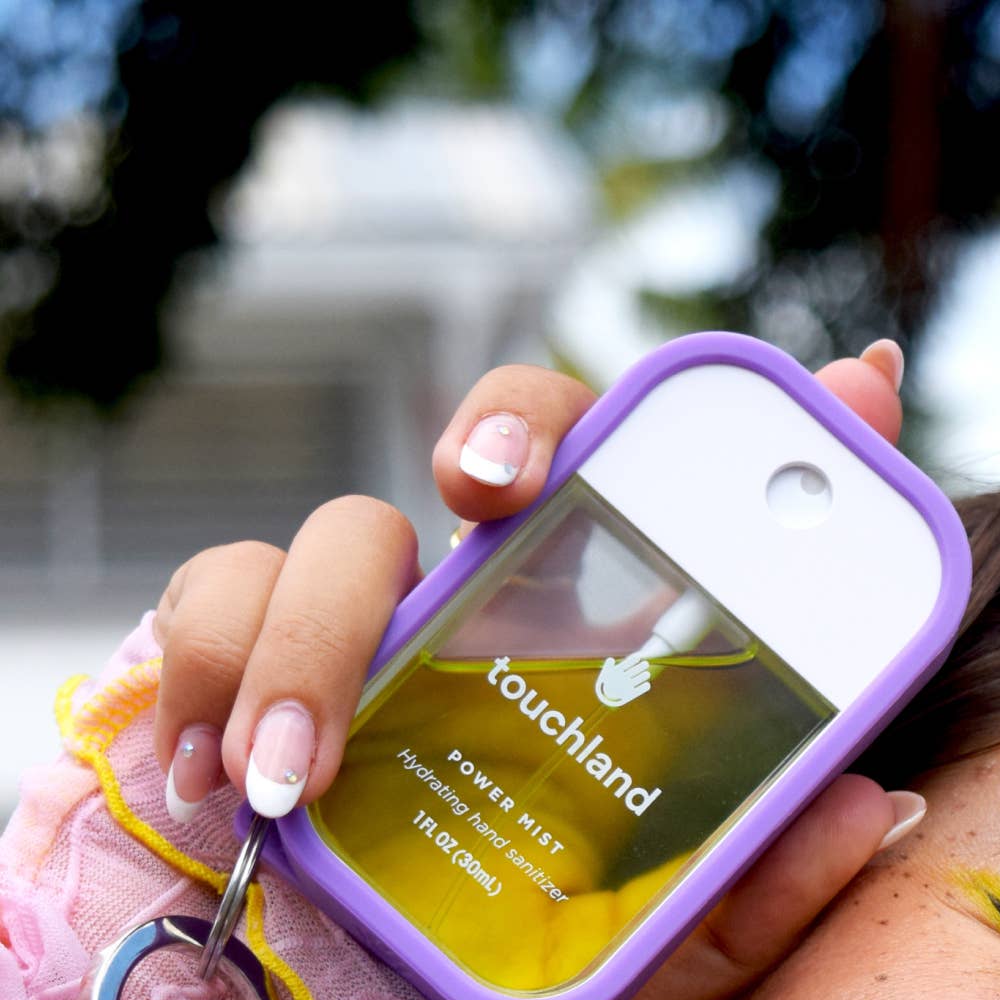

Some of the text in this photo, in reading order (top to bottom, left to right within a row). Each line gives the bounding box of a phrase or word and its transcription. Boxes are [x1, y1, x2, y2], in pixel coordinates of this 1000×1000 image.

[487, 656, 662, 817] touchland
[396, 748, 570, 903] Hydrating hand sanitizer
[434, 831, 459, 855] OZ
[451, 849, 503, 897] (30mL)
[447, 749, 564, 855] POWER MIST
